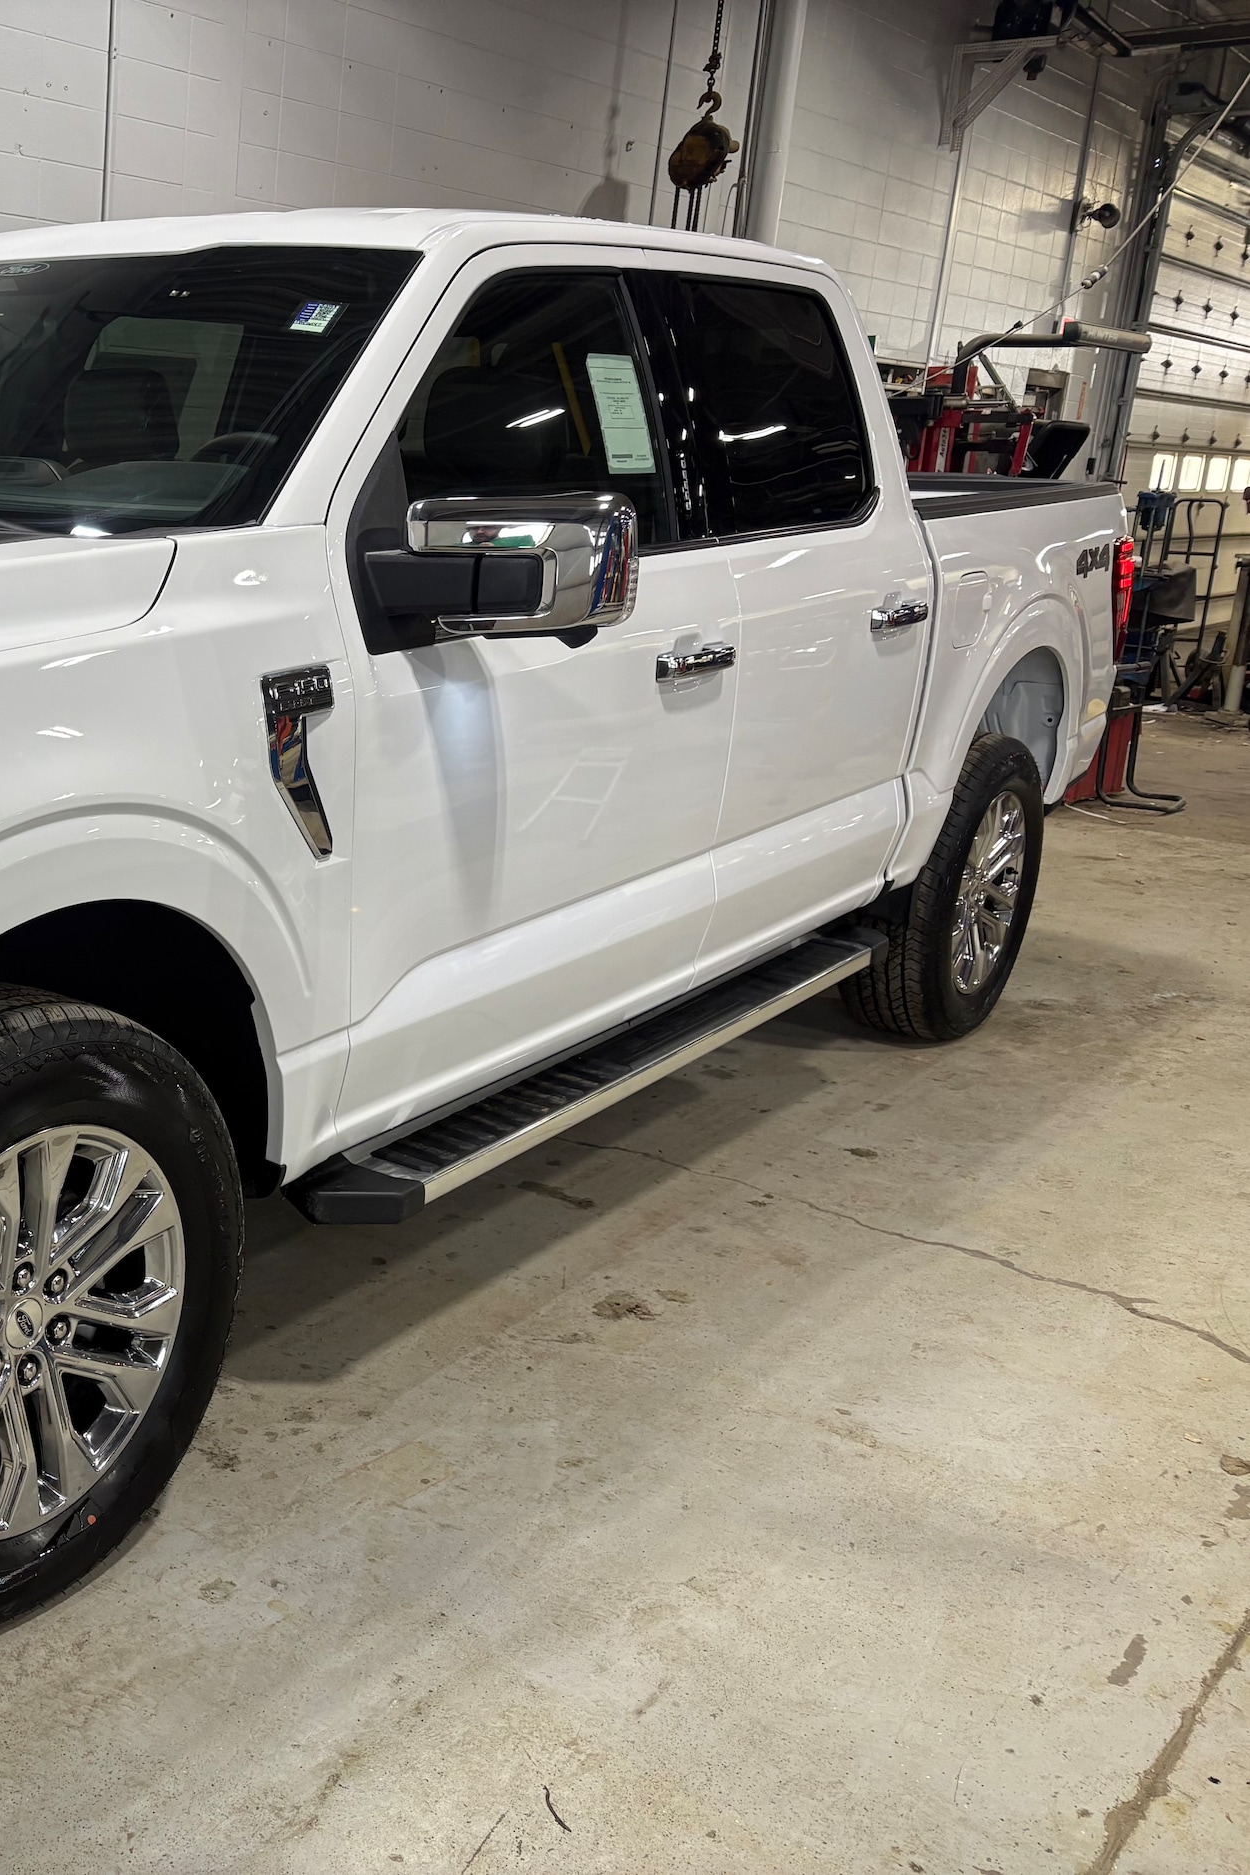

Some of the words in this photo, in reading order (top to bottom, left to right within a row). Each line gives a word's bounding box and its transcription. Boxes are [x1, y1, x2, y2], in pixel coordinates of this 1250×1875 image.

[1086, 328, 1118, 343] HUNTER
[269, 674, 329, 700] F-150
[17, 1314, 32, 1335] Ford
